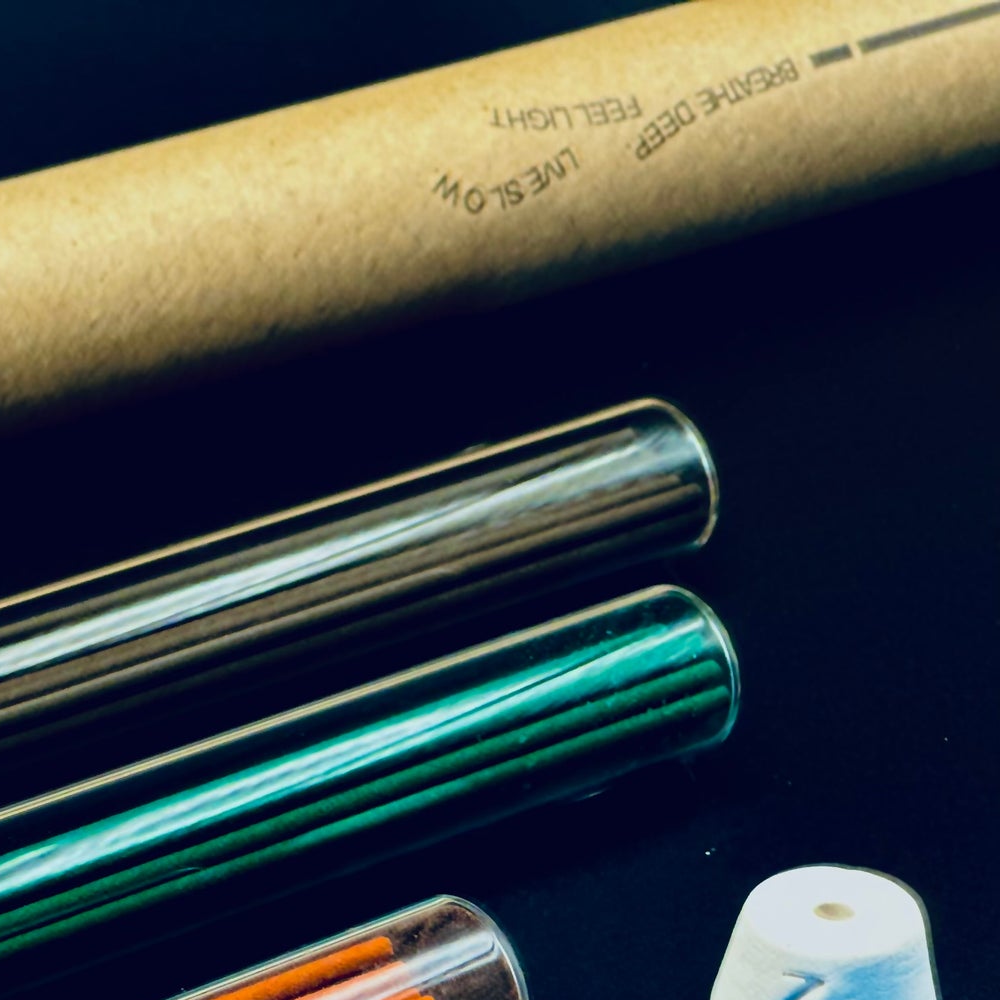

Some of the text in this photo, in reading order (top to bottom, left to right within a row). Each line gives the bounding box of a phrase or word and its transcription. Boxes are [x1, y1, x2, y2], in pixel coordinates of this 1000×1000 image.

[573, 95, 643, 127] FEEL
[695, 57, 799, 116] BREATHE
[519, 146, 580, 196] LIVE
